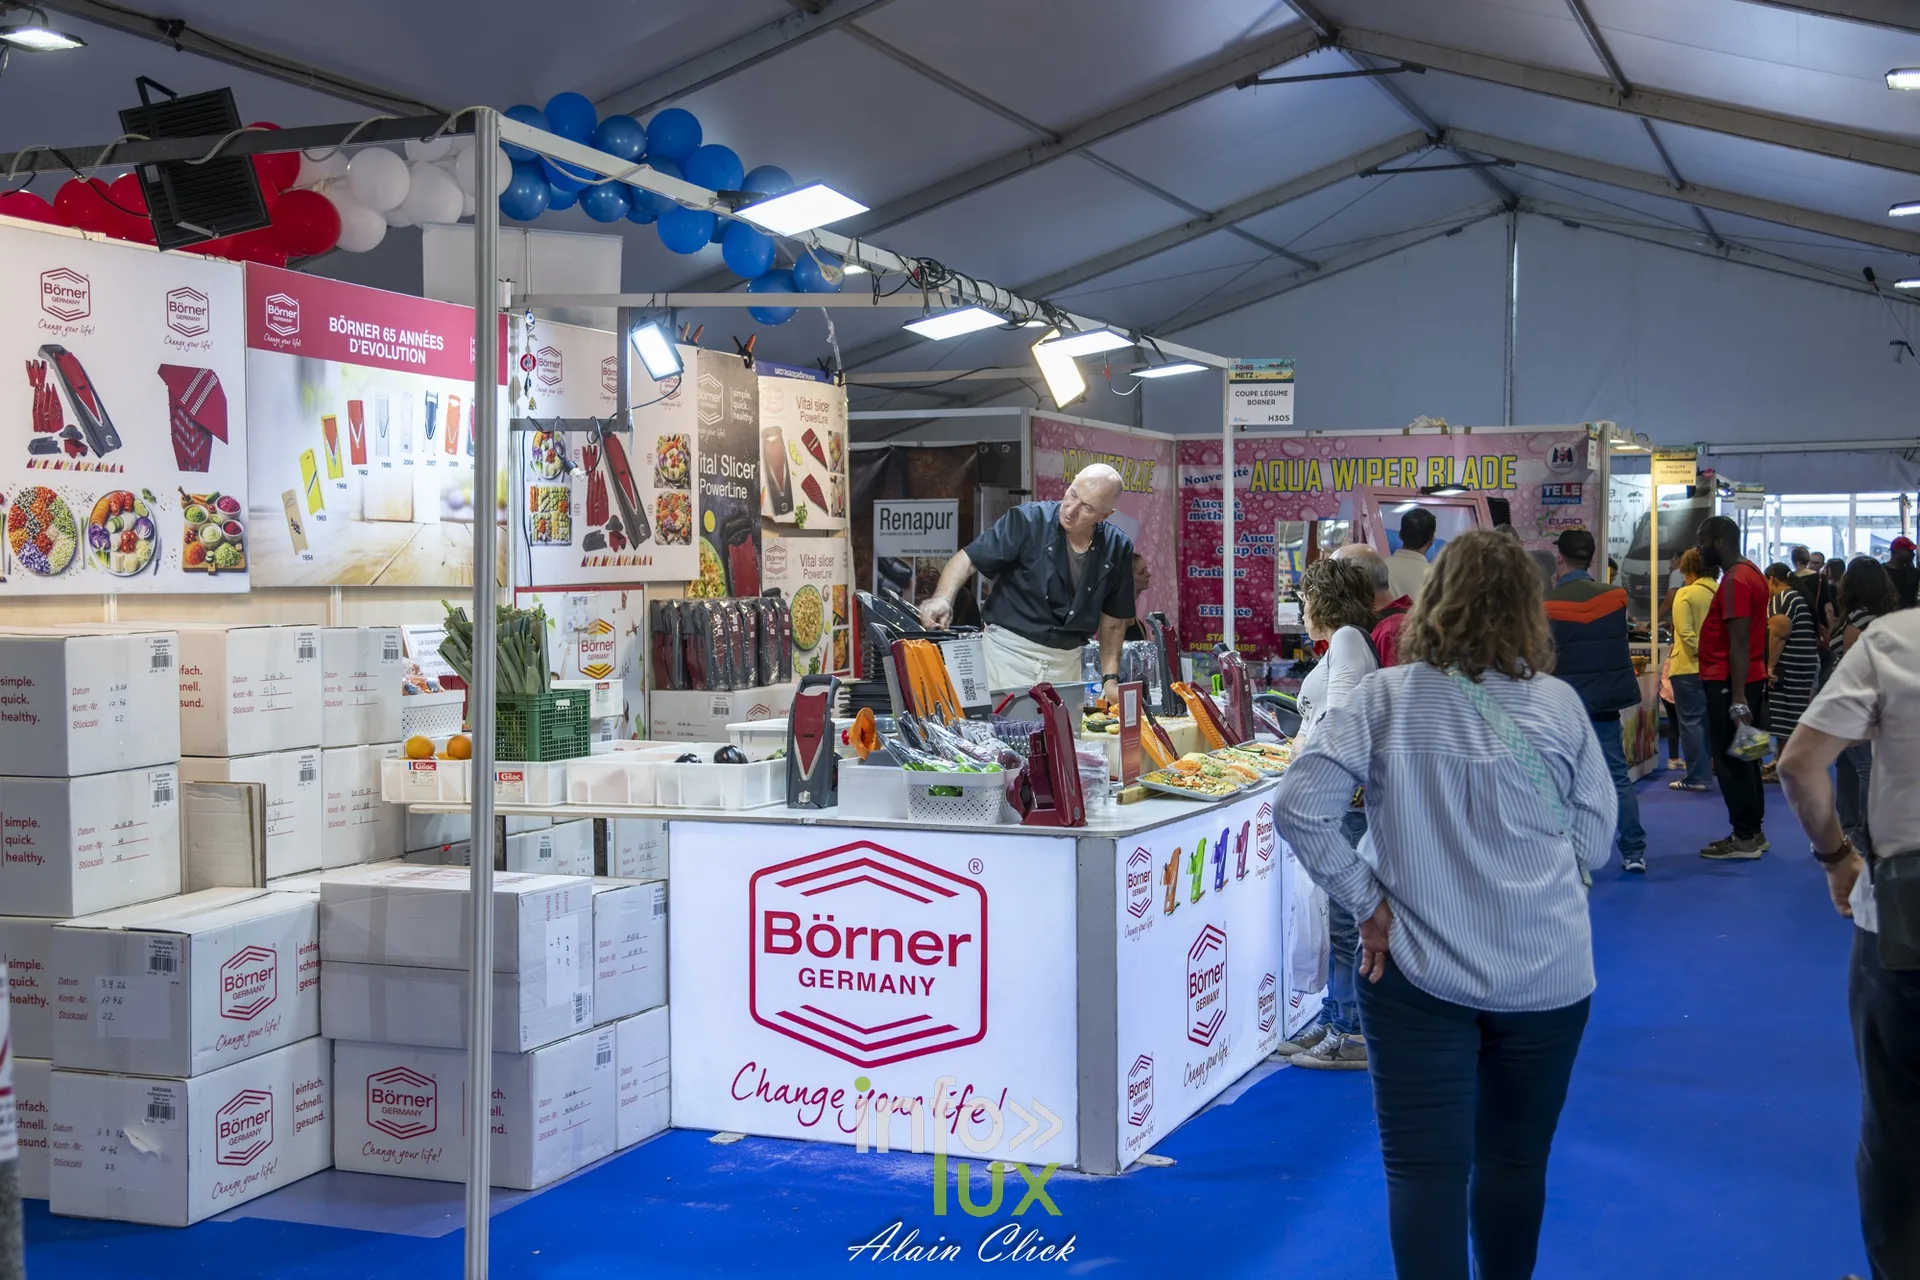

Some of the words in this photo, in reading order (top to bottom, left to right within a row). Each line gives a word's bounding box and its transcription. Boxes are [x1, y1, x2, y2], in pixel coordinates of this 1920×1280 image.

[44, 282, 87, 300] Börner
[51, 296, 81, 306] GERMANY
[169, 301, 206, 317] Börner
[268, 304, 298, 319] Börner
[38, 318, 63, 335] Change
[329, 315, 380, 341] BÖRNER
[383, 326, 397, 342] 65
[399, 326, 445, 350] ANNÉES
[538, 357, 561, 369] Börner
[1260, 389, 1288, 397] LÉGUME
[796, 395, 813, 411] Vital
[814, 398, 830, 413] slicer
[800, 411, 829, 425] PowerLine
[1268, 414, 1290, 422] H305
[720, 454, 756, 480] Slicer
[1250, 458, 1323, 493] AQUA
[1331, 456, 1418, 492] WIPER
[1426, 454, 1518, 491] BLADE
[1184, 466, 1249, 486] Nouveté
[700, 478, 748, 500] PowerLine
[1543, 485, 1581, 496] TELE
[1191, 498, 1241, 510] Aucue
[880, 508, 953, 535] Renapur
[1188, 510, 1245, 521] méthe
[1549, 517, 1583, 525] EURO
[1240, 533, 1275, 544] Aucu
[1216, 545, 1250, 557] cup
[1253, 545, 1268, 555] de
[800, 553, 817, 567] Vital
[818, 554, 834, 567] slicer
[803, 568, 832, 580] PowerLine
[1188, 566, 1246, 578] Pratie
[1198, 604, 1253, 618] Effice
[581, 639, 614, 653] Börner
[180, 664, 203, 676] fach.
[0, 675, 35, 690] simple.
[180, 680, 202, 692] nell.
[72, 686, 90, 696] Datum
[1, 693, 30, 708] quick.
[180, 697, 205, 708] sund.
[1, 710, 41, 726] healthy.
[415, 762, 435, 770] Gilac
[501, 772, 521, 781] Gilac
[5, 816, 41, 829] simple.
[1257, 820, 1273, 837] Börner
[77, 825, 96, 836] Datum
[5, 833, 35, 847] quick.
[5, 851, 46, 865] healthy.
[1128, 869, 1151, 889] Börner
[764, 910, 972, 967] Börner
[298, 941, 317, 955] einfa
[8, 958, 44, 971] simple.
[9, 976, 39, 989] quick.
[58, 976, 79, 986] Datum
[224, 965, 274, 993] Börner
[798, 967, 936, 997] GERMANY
[1189, 961, 1225, 999] Börner
[232, 983, 266, 1001] GERMANY
[9, 993, 50, 1008] healthy.
[1195, 988, 1220, 1013] GERMANY
[1258, 990, 1275, 1010] Börner
[58, 1011, 89, 1021] Stückzahl
[102, 1012, 114, 1021] 22
[215, 1032, 245, 1052] Change
[244, 1027, 263, 1050] your
[263, 1015, 281, 1038] life!
[1183, 1061, 1206, 1089] Change
[1204, 1050, 1218, 1085] your
[1217, 1033, 1232, 1067] life!
[295, 1078, 325, 1095] einfach.
[1129, 1075, 1152, 1100] Börner
[295, 1095, 323, 1112] schnell.
[372, 1088, 434, 1109] Börner
[731, 1061, 845, 1128] Change
[837, 1087, 924, 1133] your
[933, 1082, 1008, 1134] life!
[15, 1100, 49, 1112] infach.
[382, 1107, 423, 1117] GERMANY
[16, 1118, 47, 1131] chnell.
[53, 1123, 74, 1133] Datum
[219, 1109, 270, 1139] Börner
[295, 1113, 326, 1132] gesund.
[17, 1136, 50, 1149] esund.
[228, 1127, 262, 1146] GERMANY
[362, 1141, 398, 1164] Change
[398, 1148, 420, 1164] your
[420, 1147, 443, 1164] life!
[211, 1179, 242, 1200] Change
[241, 1173, 259, 1196] your
[259, 1158, 278, 1179] life!
